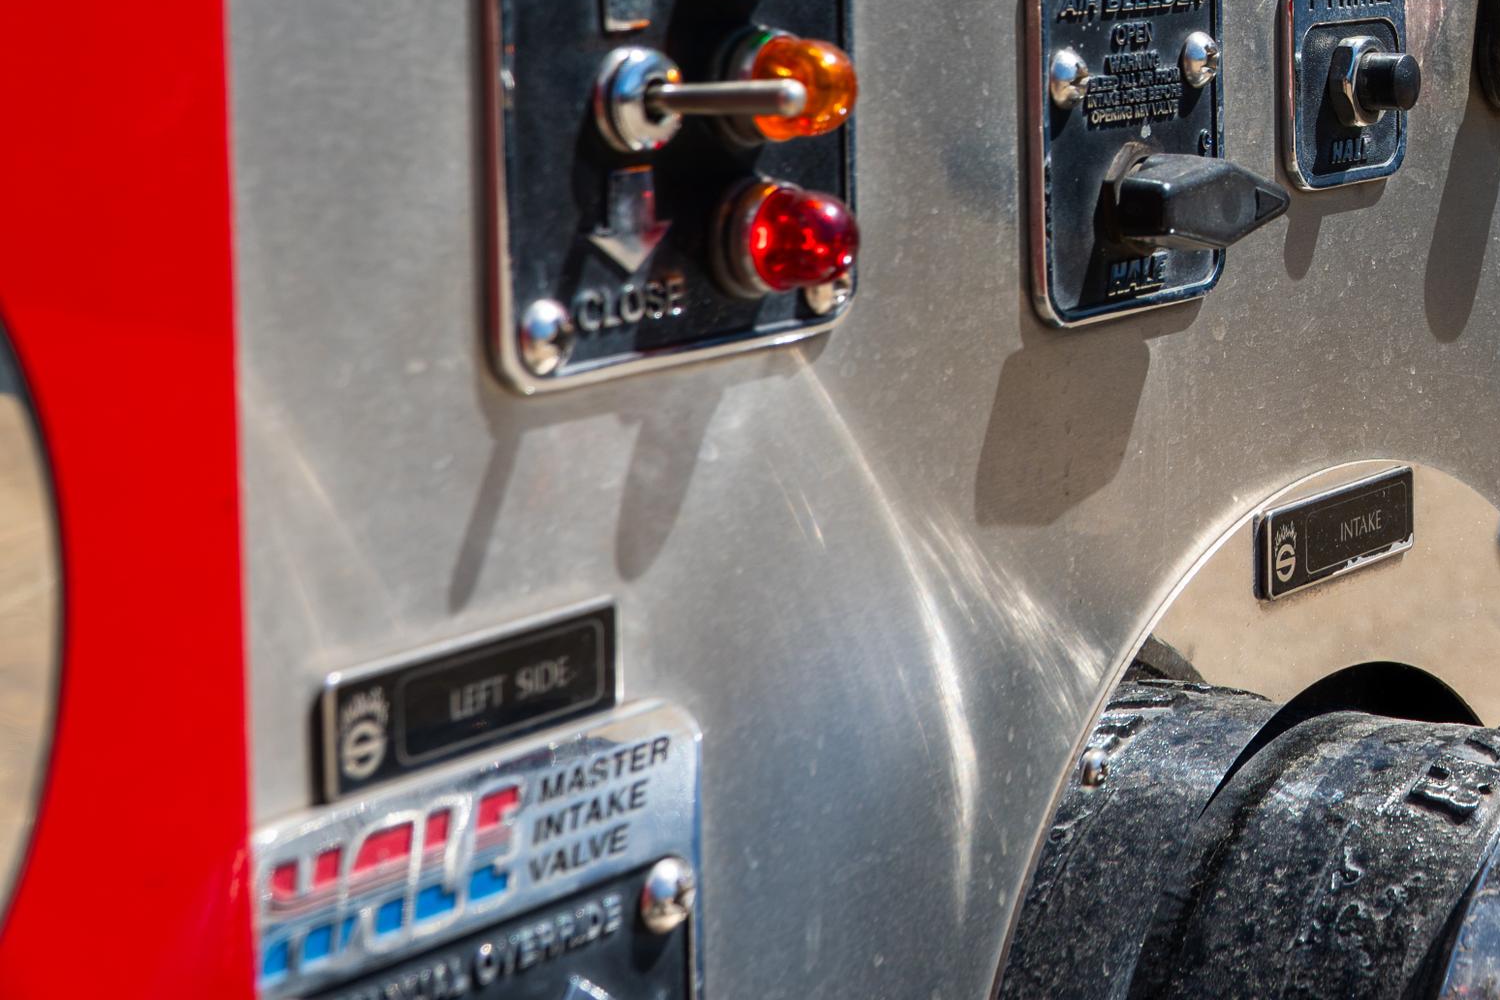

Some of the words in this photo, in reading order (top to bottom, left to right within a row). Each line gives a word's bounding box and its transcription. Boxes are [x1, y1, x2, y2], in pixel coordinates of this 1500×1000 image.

[1106, 50, 1160, 73] WARNING
[1113, 22, 1152, 46] OPEN
[1087, 90, 1122, 109] INTAKE
[1148, 83, 1184, 102] BEFORE
[577, 270, 686, 333] CLOSE
[1340, 509, 1382, 542] INTAKE
[449, 678, 507, 722] LEFT
[514, 655, 575, 700] SIDE
[539, 734, 671, 803] MASTER
[532, 778, 650, 846] INTAKE
[528, 821, 630, 882] VALVE
[473, 893, 624, 988] OVERRIDE
